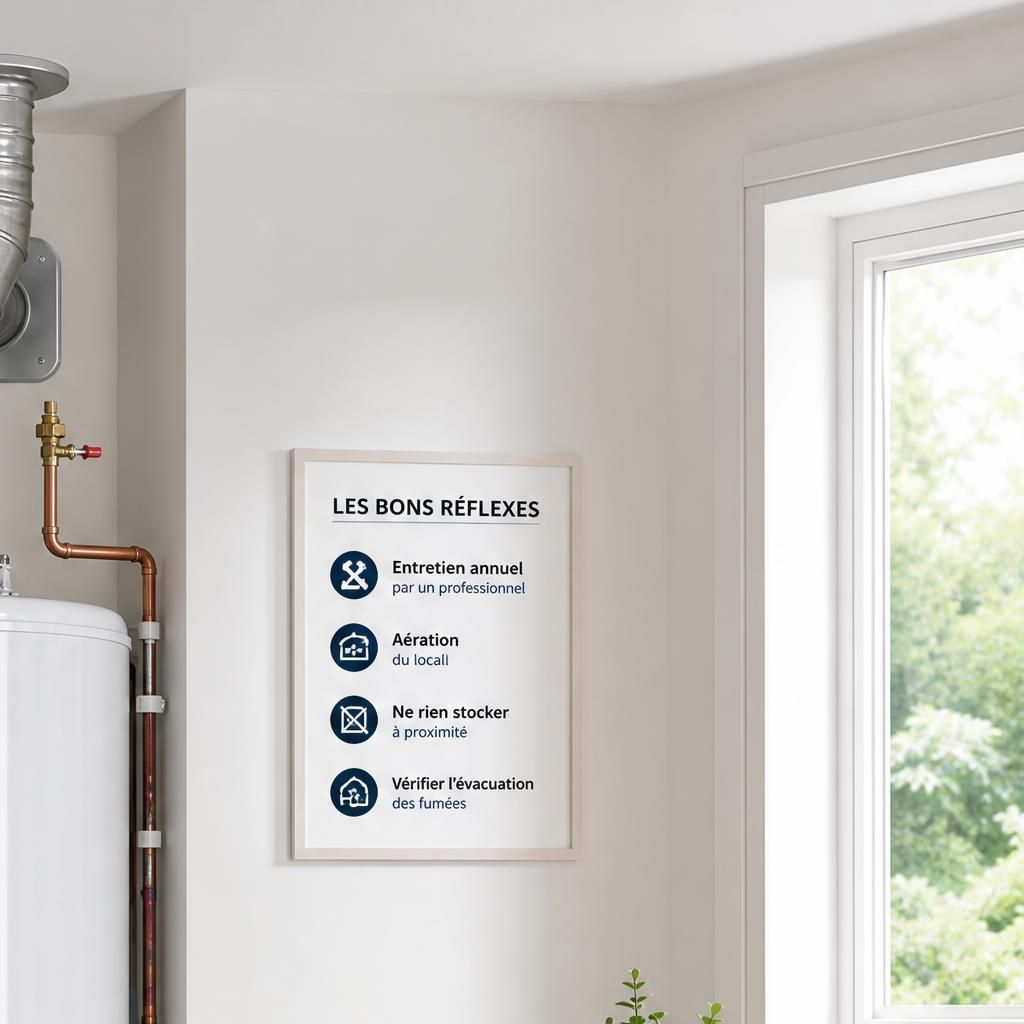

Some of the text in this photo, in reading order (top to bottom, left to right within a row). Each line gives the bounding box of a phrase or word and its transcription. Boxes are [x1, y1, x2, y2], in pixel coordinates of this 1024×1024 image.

[333, 495, 540, 518] LES BONS RÉFLEXES
[392, 560, 524, 576] Entretien annuel
[392, 580, 526, 598] par un professionnel
[391, 632, 459, 647] Aération
[392, 653, 410, 666] du
[392, 704, 510, 719] Ne rien stocker
[392, 725, 468, 741] à proximité
[391, 776, 446, 791] Vérifier
[392, 796, 467, 810] des fumées
